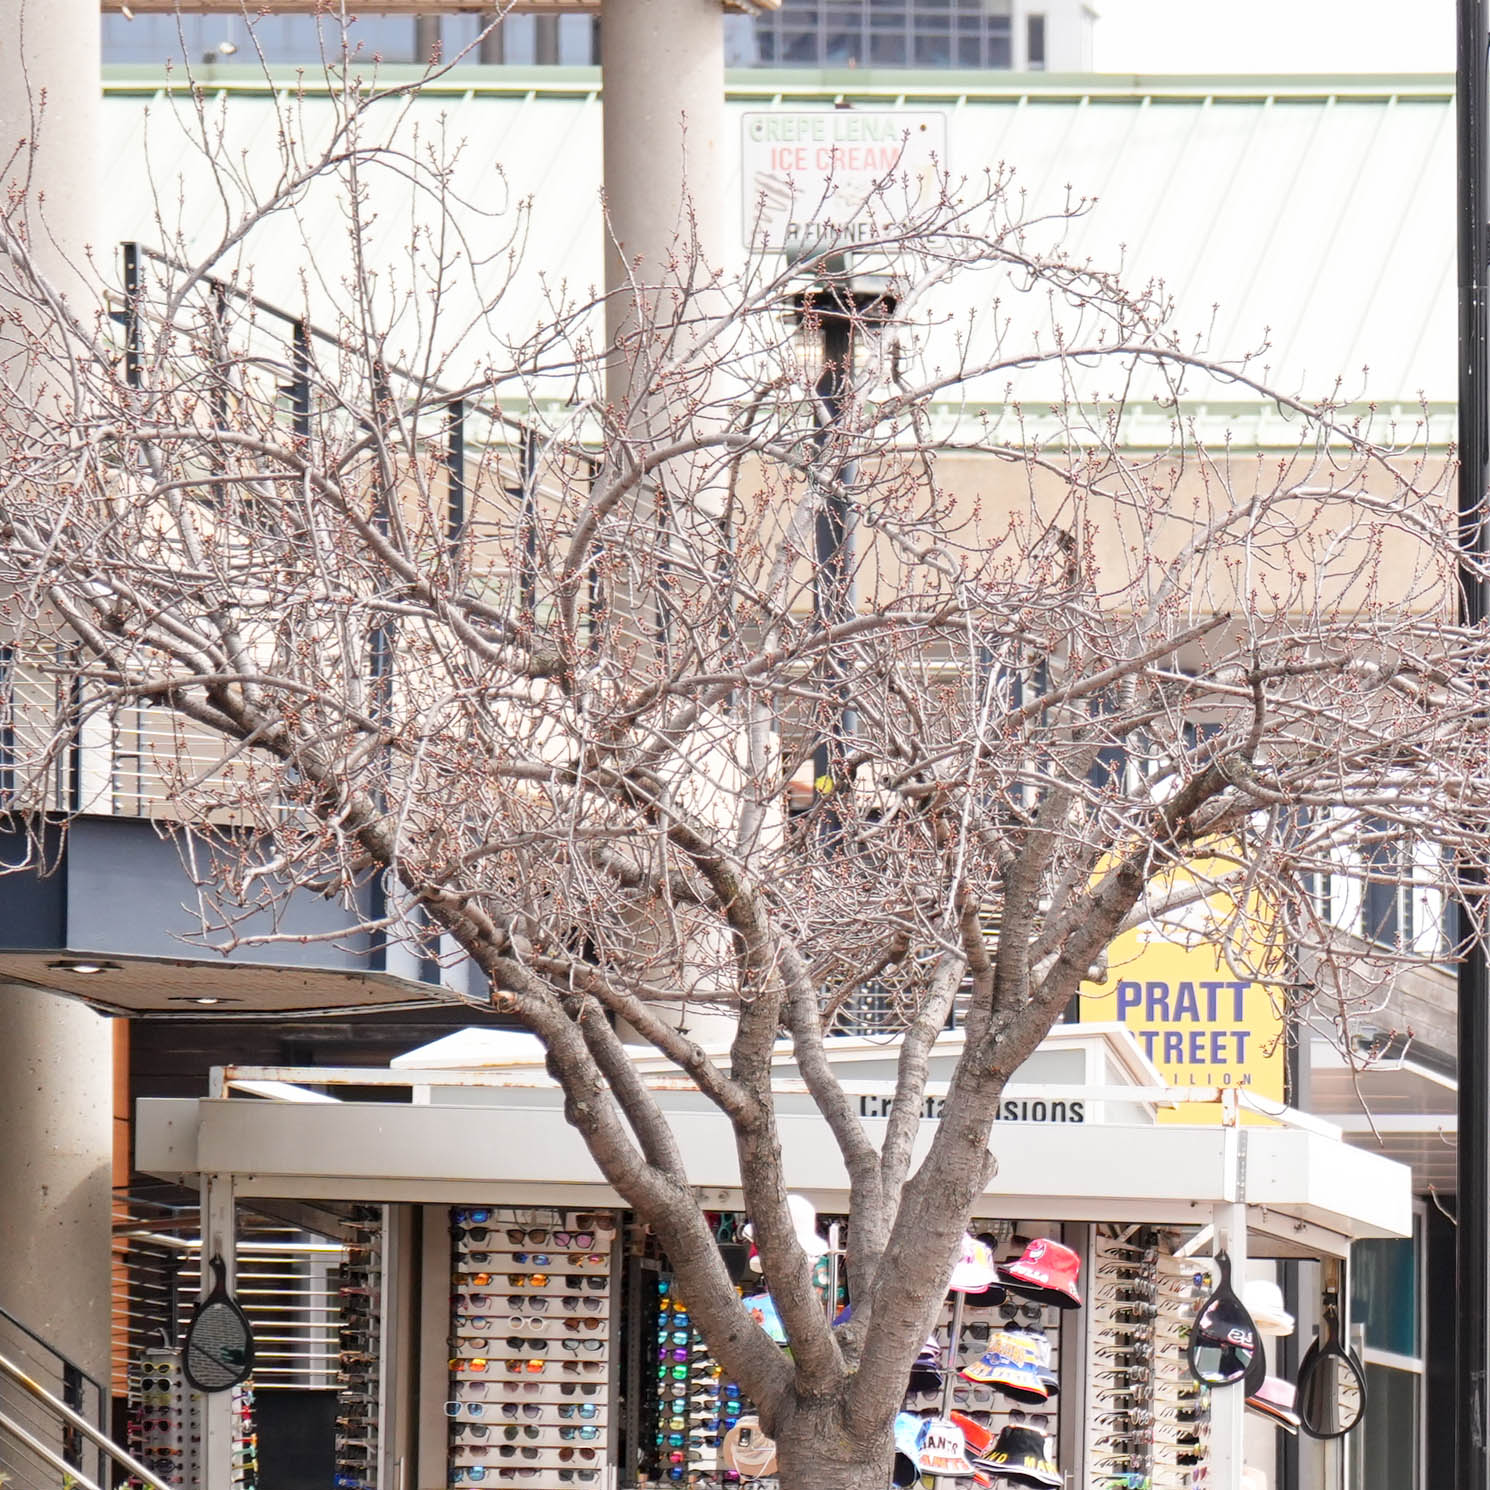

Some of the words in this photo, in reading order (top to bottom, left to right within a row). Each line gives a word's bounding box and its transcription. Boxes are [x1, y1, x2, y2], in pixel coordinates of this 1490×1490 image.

[750, 116, 825, 142] CREPE
[834, 116, 898, 142] LENA
[771, 147, 808, 171] ICE
[816, 147, 900, 171] CREAM
[1117, 981, 1252, 1023] PRATT
[1128, 1030, 1252, 1065] TREET
